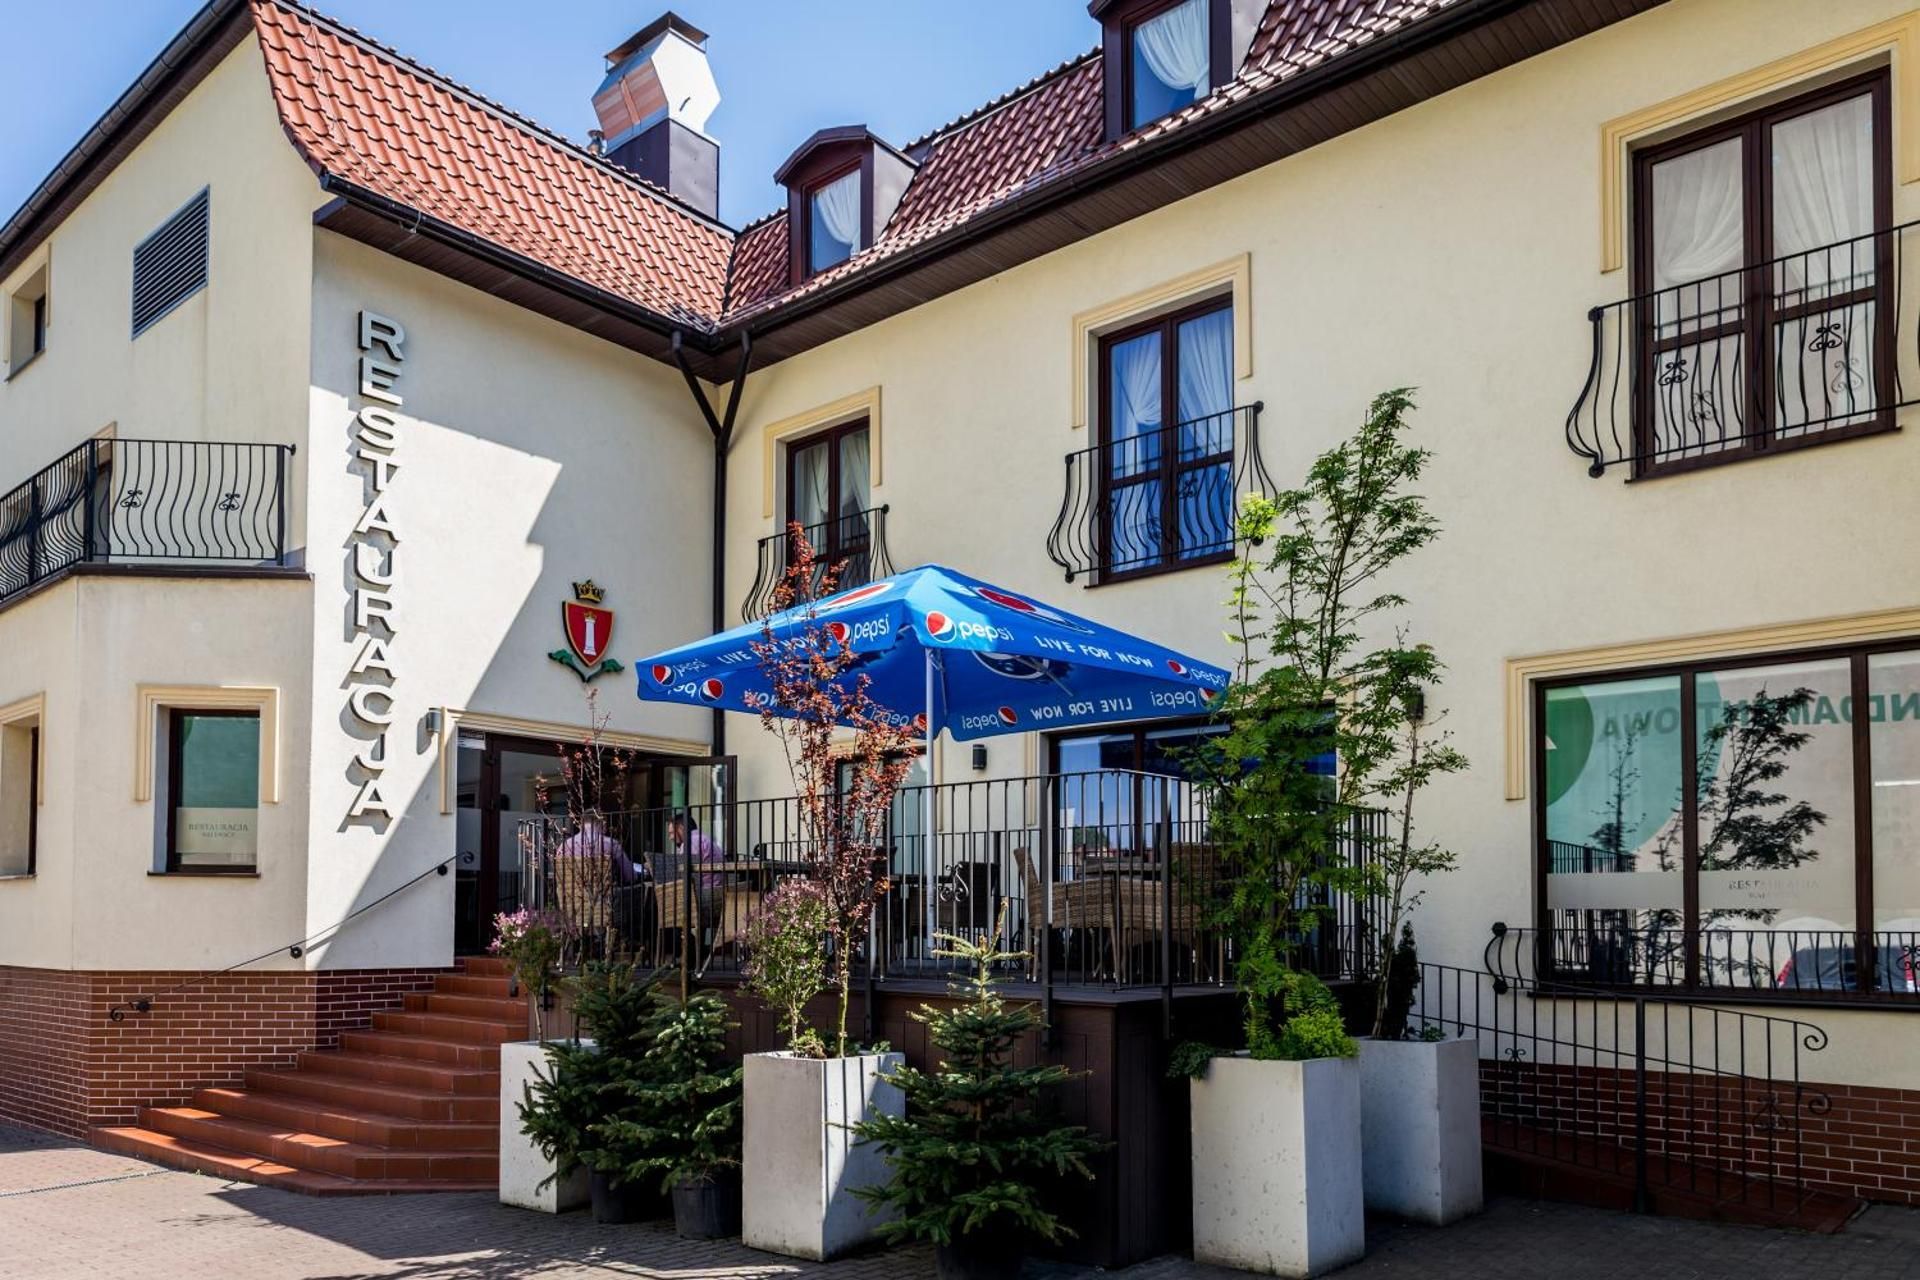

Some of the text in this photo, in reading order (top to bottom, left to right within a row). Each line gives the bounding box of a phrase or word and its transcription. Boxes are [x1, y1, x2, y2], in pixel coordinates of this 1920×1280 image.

[349, 309, 406, 821] RESTAURACJA
[853, 614, 890, 644] pepsi
[958, 620, 1014, 642] pepsi
[717, 650, 751, 665] LIVE
[1034, 635, 1155, 669] LIVE FOR NOW
[1191, 667, 1226, 687] pepsi
